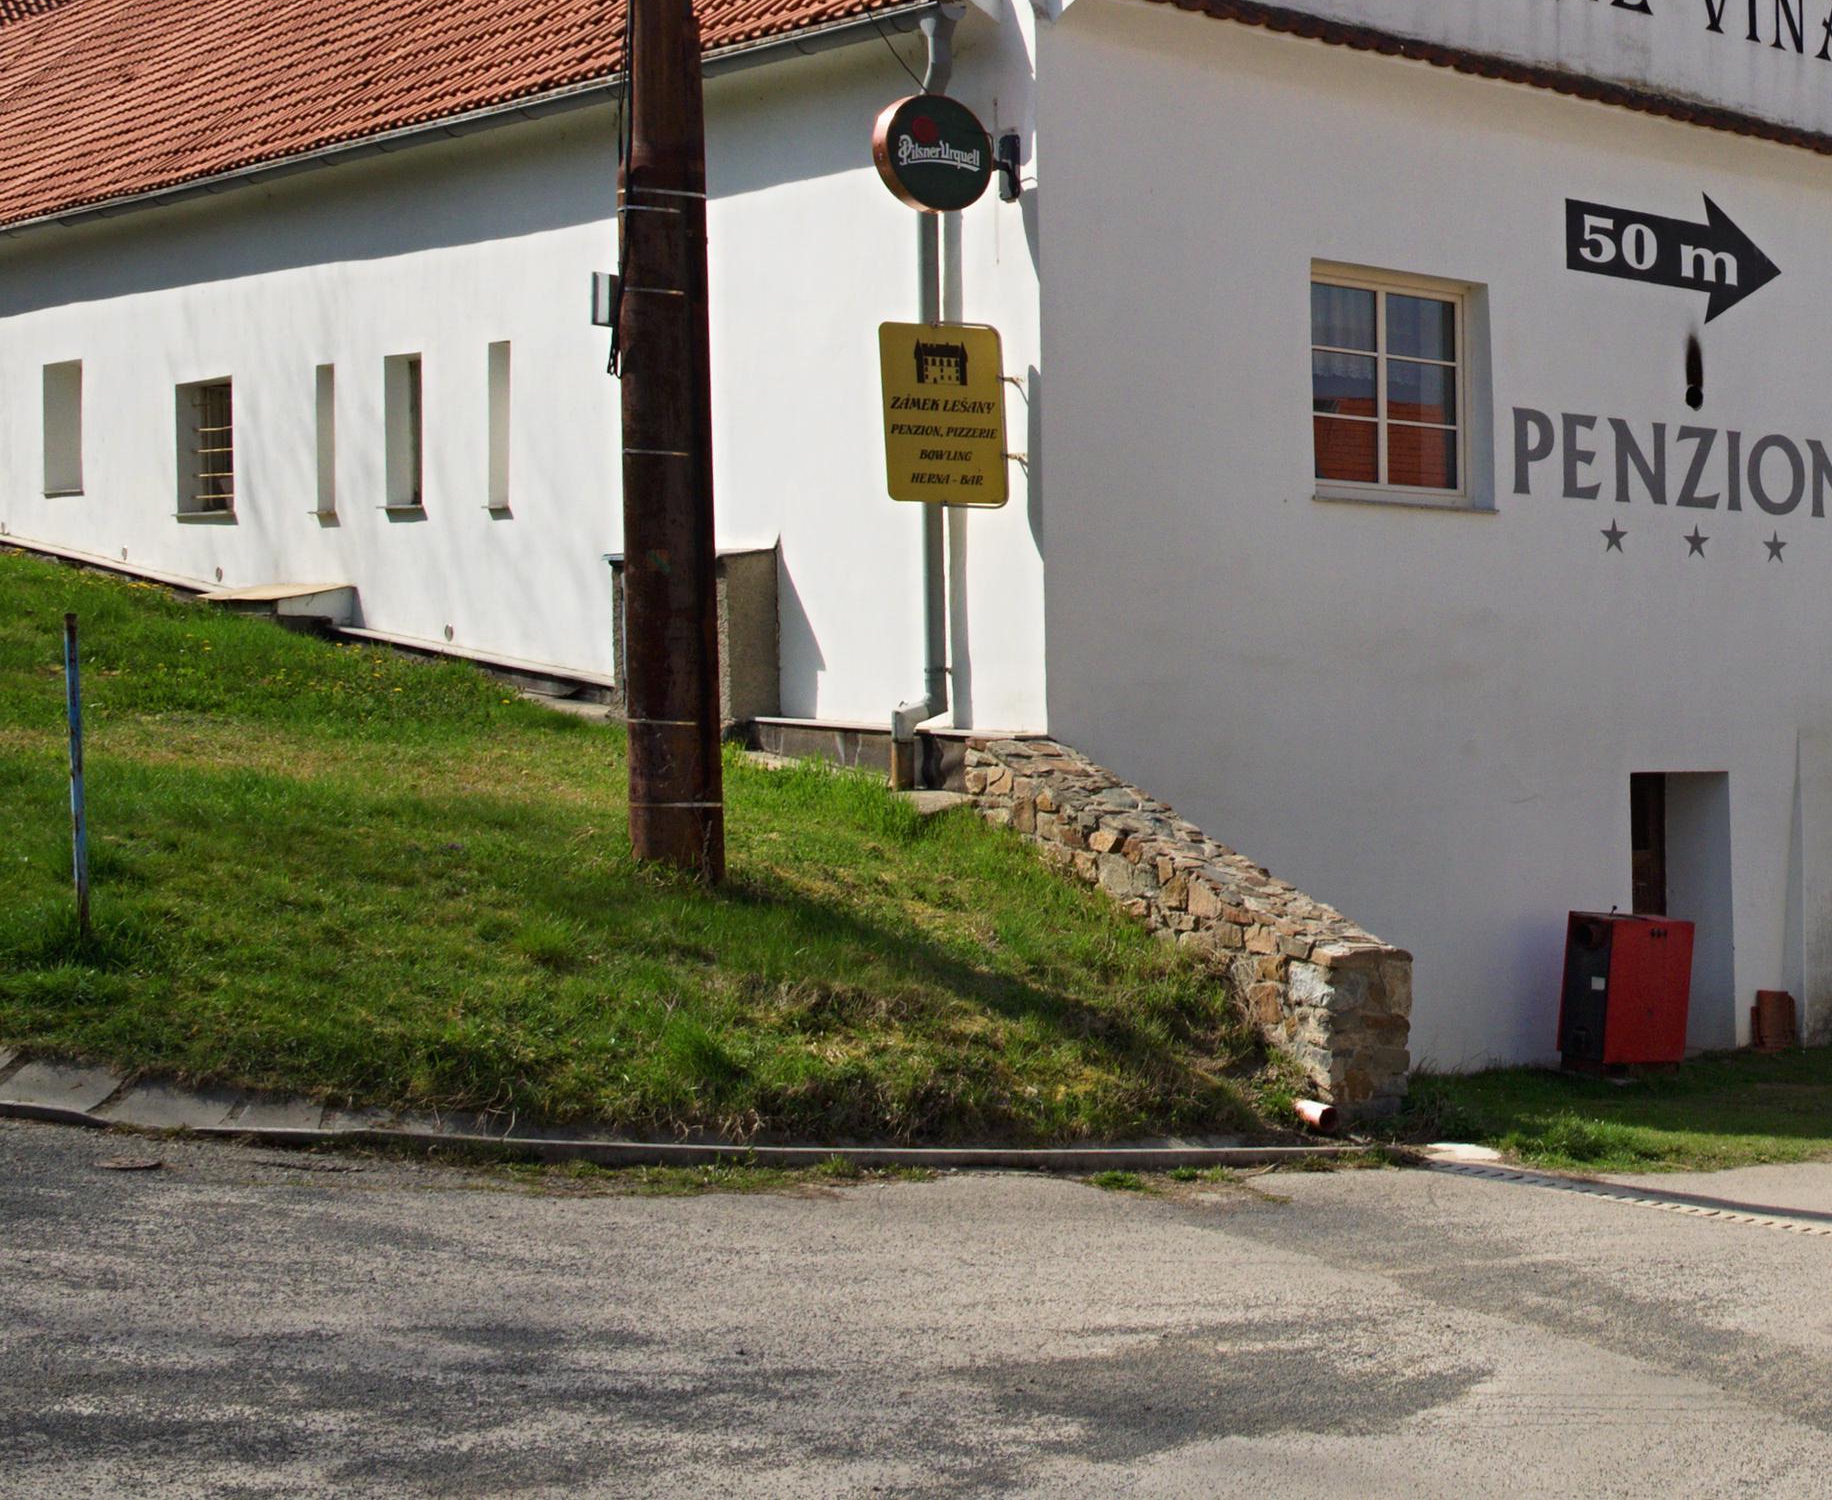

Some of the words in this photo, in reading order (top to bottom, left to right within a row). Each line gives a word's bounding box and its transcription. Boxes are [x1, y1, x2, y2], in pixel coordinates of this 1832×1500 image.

[898, 134, 940, 166] Pilsner
[940, 140, 980, 169] Urquell
[1578, 213, 1658, 271] 50
[1680, 242, 1739, 287] m
[890, 394, 941, 411] ZÁMEK
[942, 397, 996, 414] LEŠANY
[890, 423, 943, 438] PENZION,
[945, 426, 999, 439] PIZZERIE
[919, 449, 973, 461] BOWLING
[910, 472, 951, 485] HERNA
[959, 474, 984, 486] BAR
